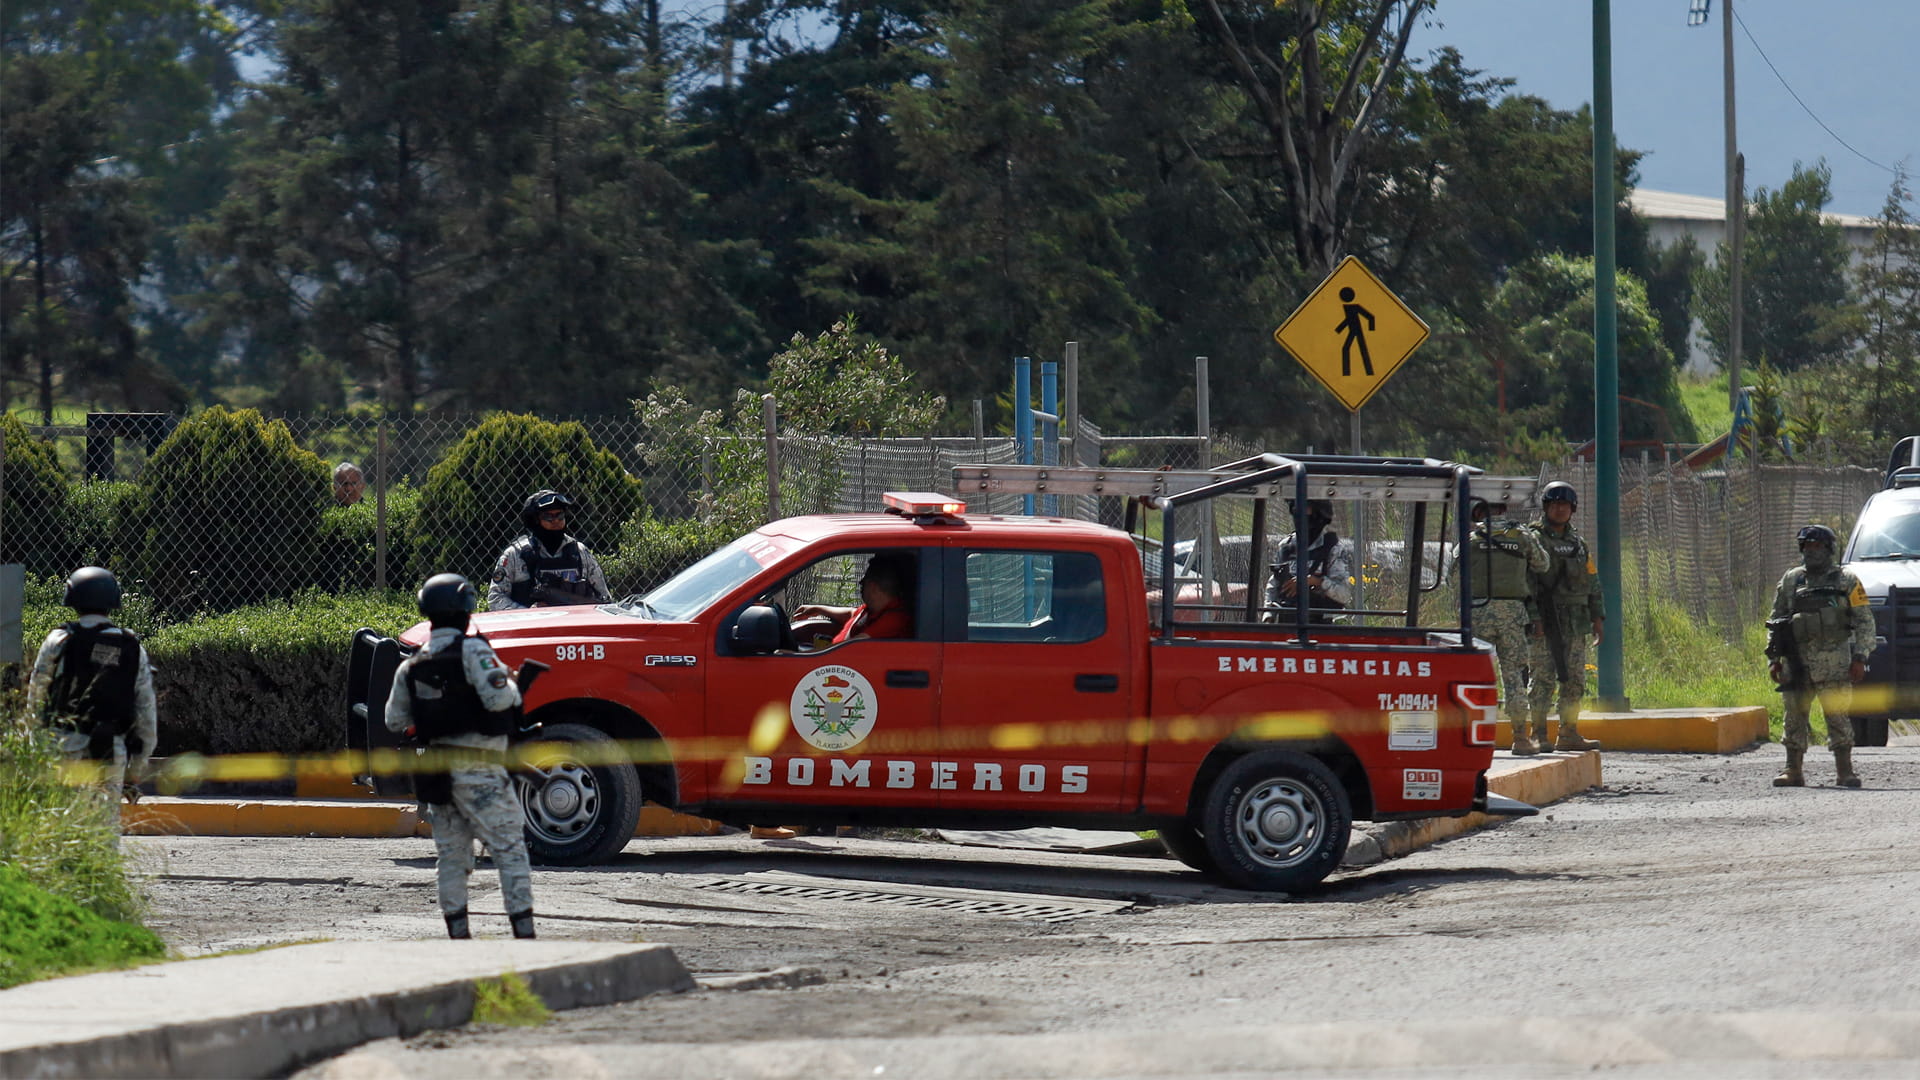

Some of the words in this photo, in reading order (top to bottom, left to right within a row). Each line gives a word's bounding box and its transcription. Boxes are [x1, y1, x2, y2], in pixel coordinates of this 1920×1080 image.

[556, 644, 605, 661] 981-B
[815, 667, 856, 679] BOMBEROS
[1218, 656, 1432, 677] EMERGENCIAS
[815, 739, 849, 749] TLAXCALA
[743, 756, 1089, 793] BOMBEROS
[1407, 772, 1438, 782] 911
